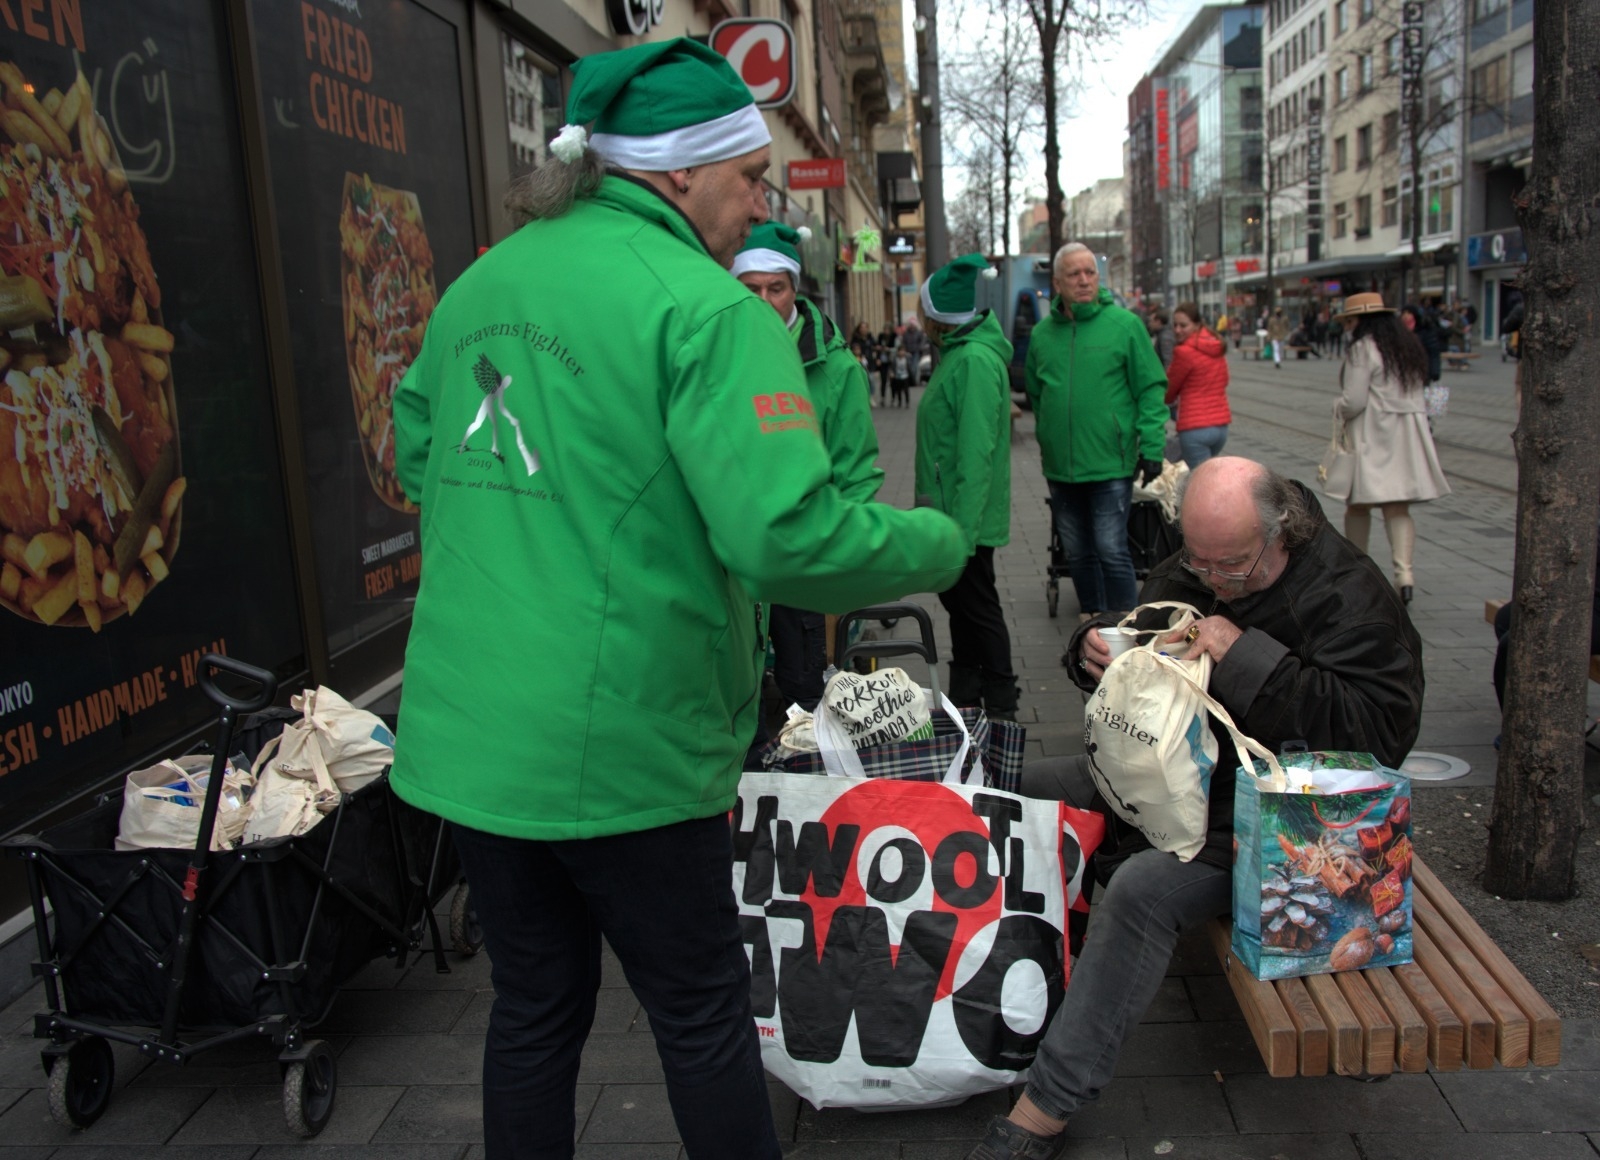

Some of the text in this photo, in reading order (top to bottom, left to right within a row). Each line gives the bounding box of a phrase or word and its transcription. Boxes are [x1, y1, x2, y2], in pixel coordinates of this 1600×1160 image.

[301, 1, 373, 83] FRIED
[309, 71, 407, 155] CHICKEN
[453, 322, 585, 378] Heavens Fighter
[467, 457, 492, 470] 2019
[468, 480, 482, 488] und
[362, 543, 381, 565] SWEET
[365, 564, 394, 600] FRESH
[57, 665, 167, 746] HANDMADE
[907, 710, 918, 726] &
